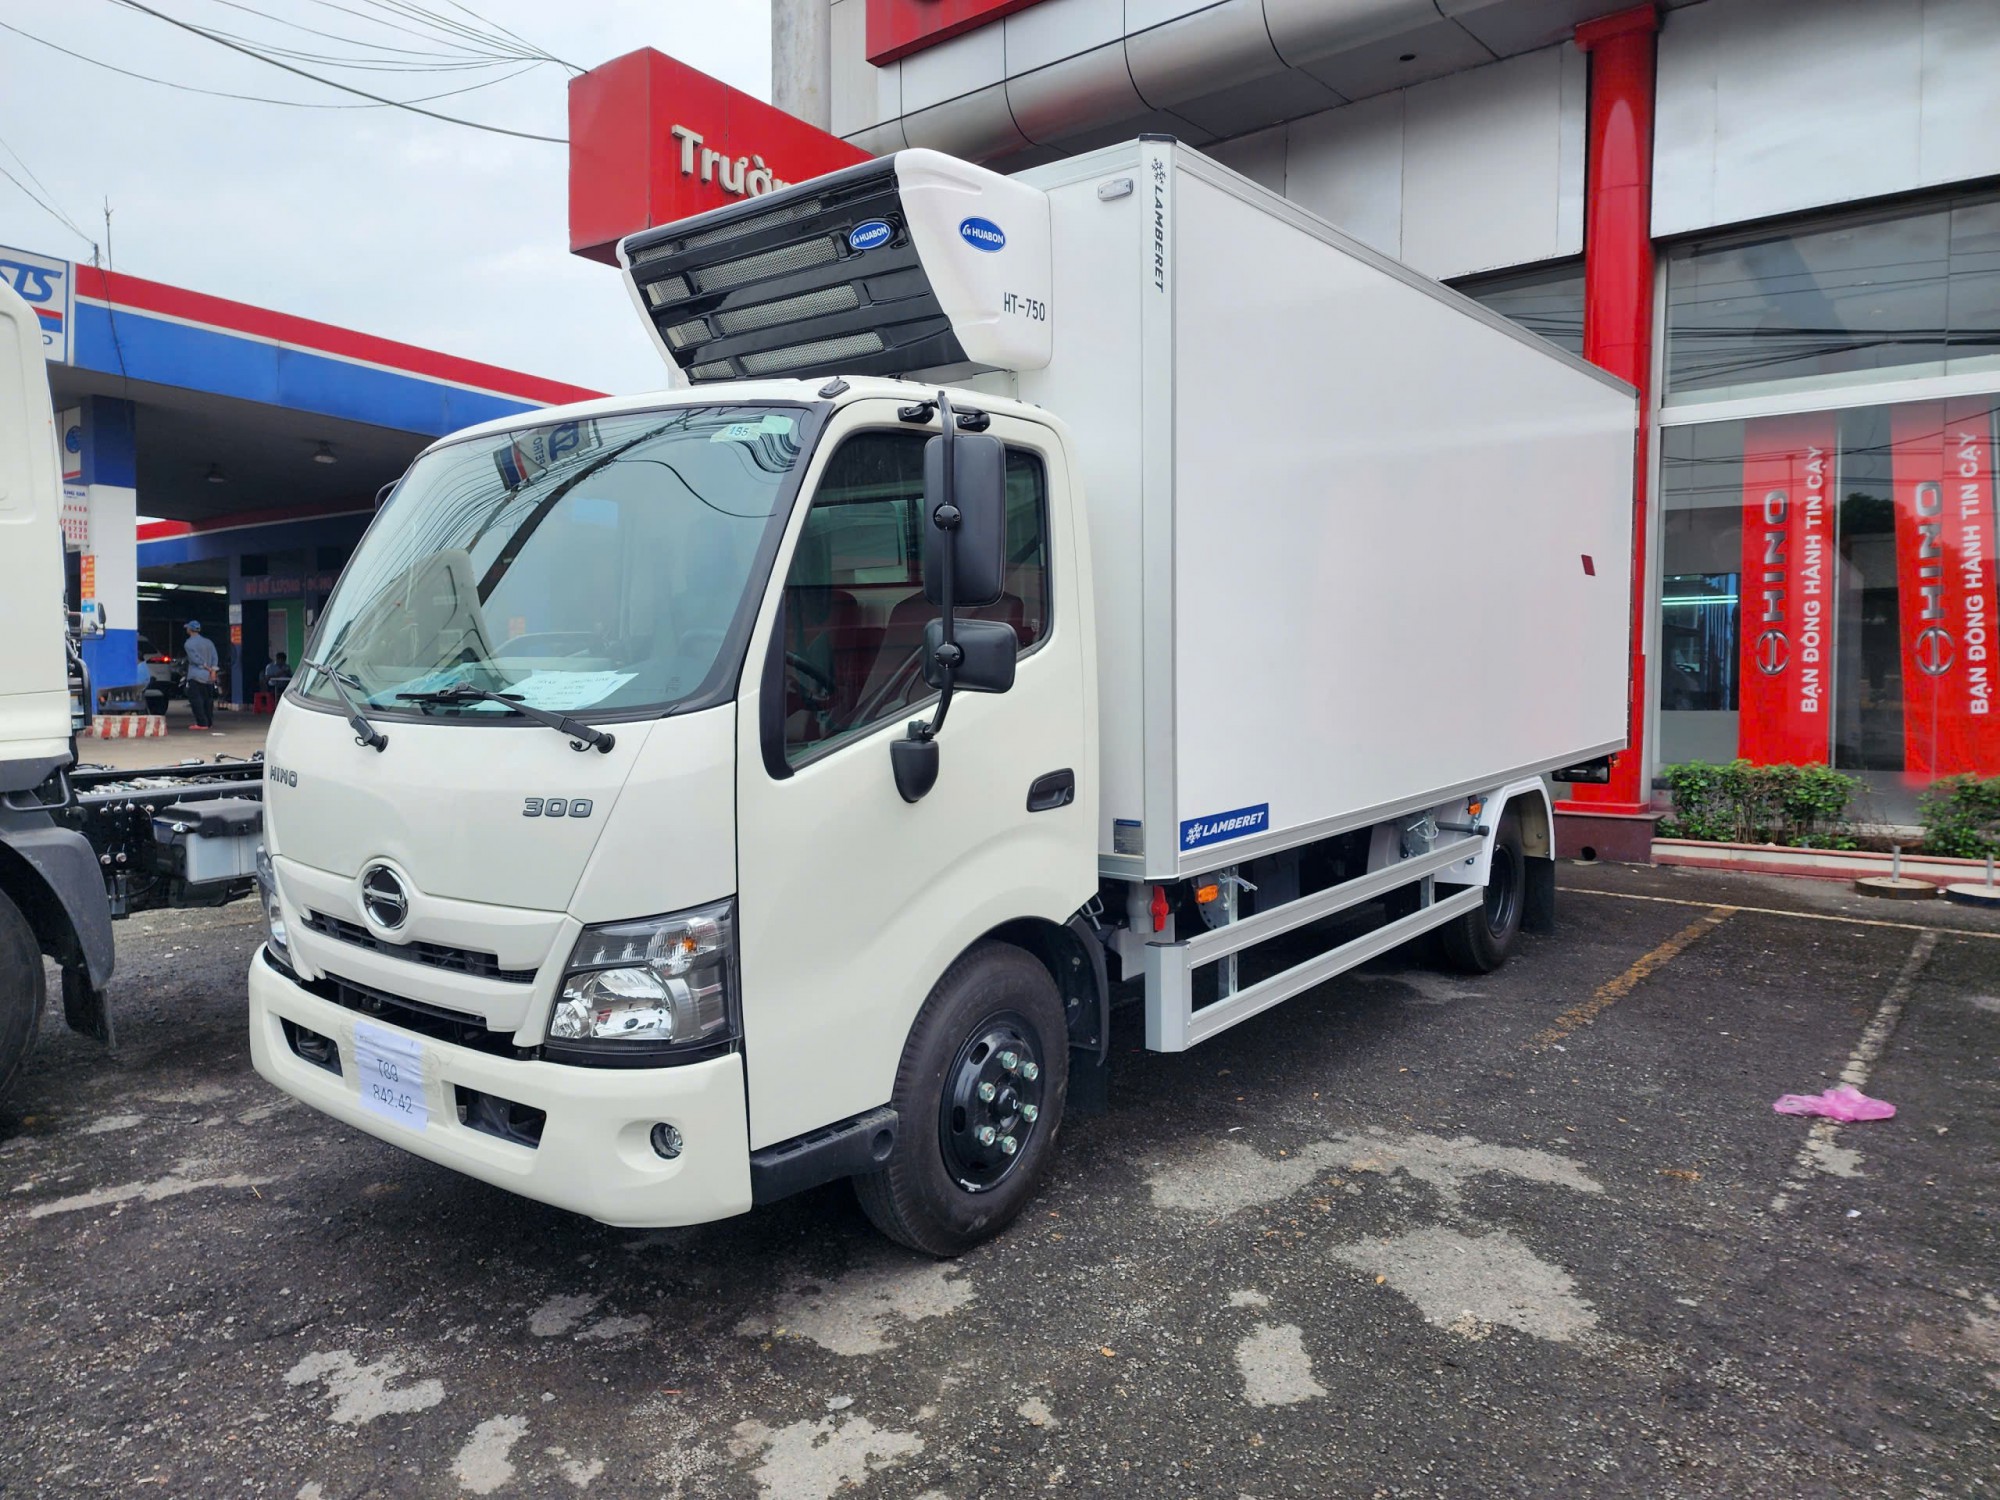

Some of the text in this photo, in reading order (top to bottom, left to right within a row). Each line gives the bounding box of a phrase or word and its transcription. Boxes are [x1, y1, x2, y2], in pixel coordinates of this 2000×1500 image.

[859, 226, 888, 242] HUABON
[972, 227, 1004, 244] HUABON
[1154, 185, 1164, 293] LAMBERET
[1003, 292, 1046, 321] HT-750
[1805, 496, 1822, 529] TIN
[1960, 484, 1980, 520] TIN
[1763, 488, 1788, 622] HINO
[1801, 535, 1821, 594] HÀNH
[1916, 481, 1945, 619] HINO
[1960, 525, 1984, 589] HÀNH
[1800, 668, 1823, 713] BẠN
[1968, 667, 1992, 714] BẠN
[270, 765, 298, 788] HINO
[522, 797, 593, 818] 300
[1201, 811, 1264, 837] LAMBERET
[373, 1084, 413, 1115] 842.42
